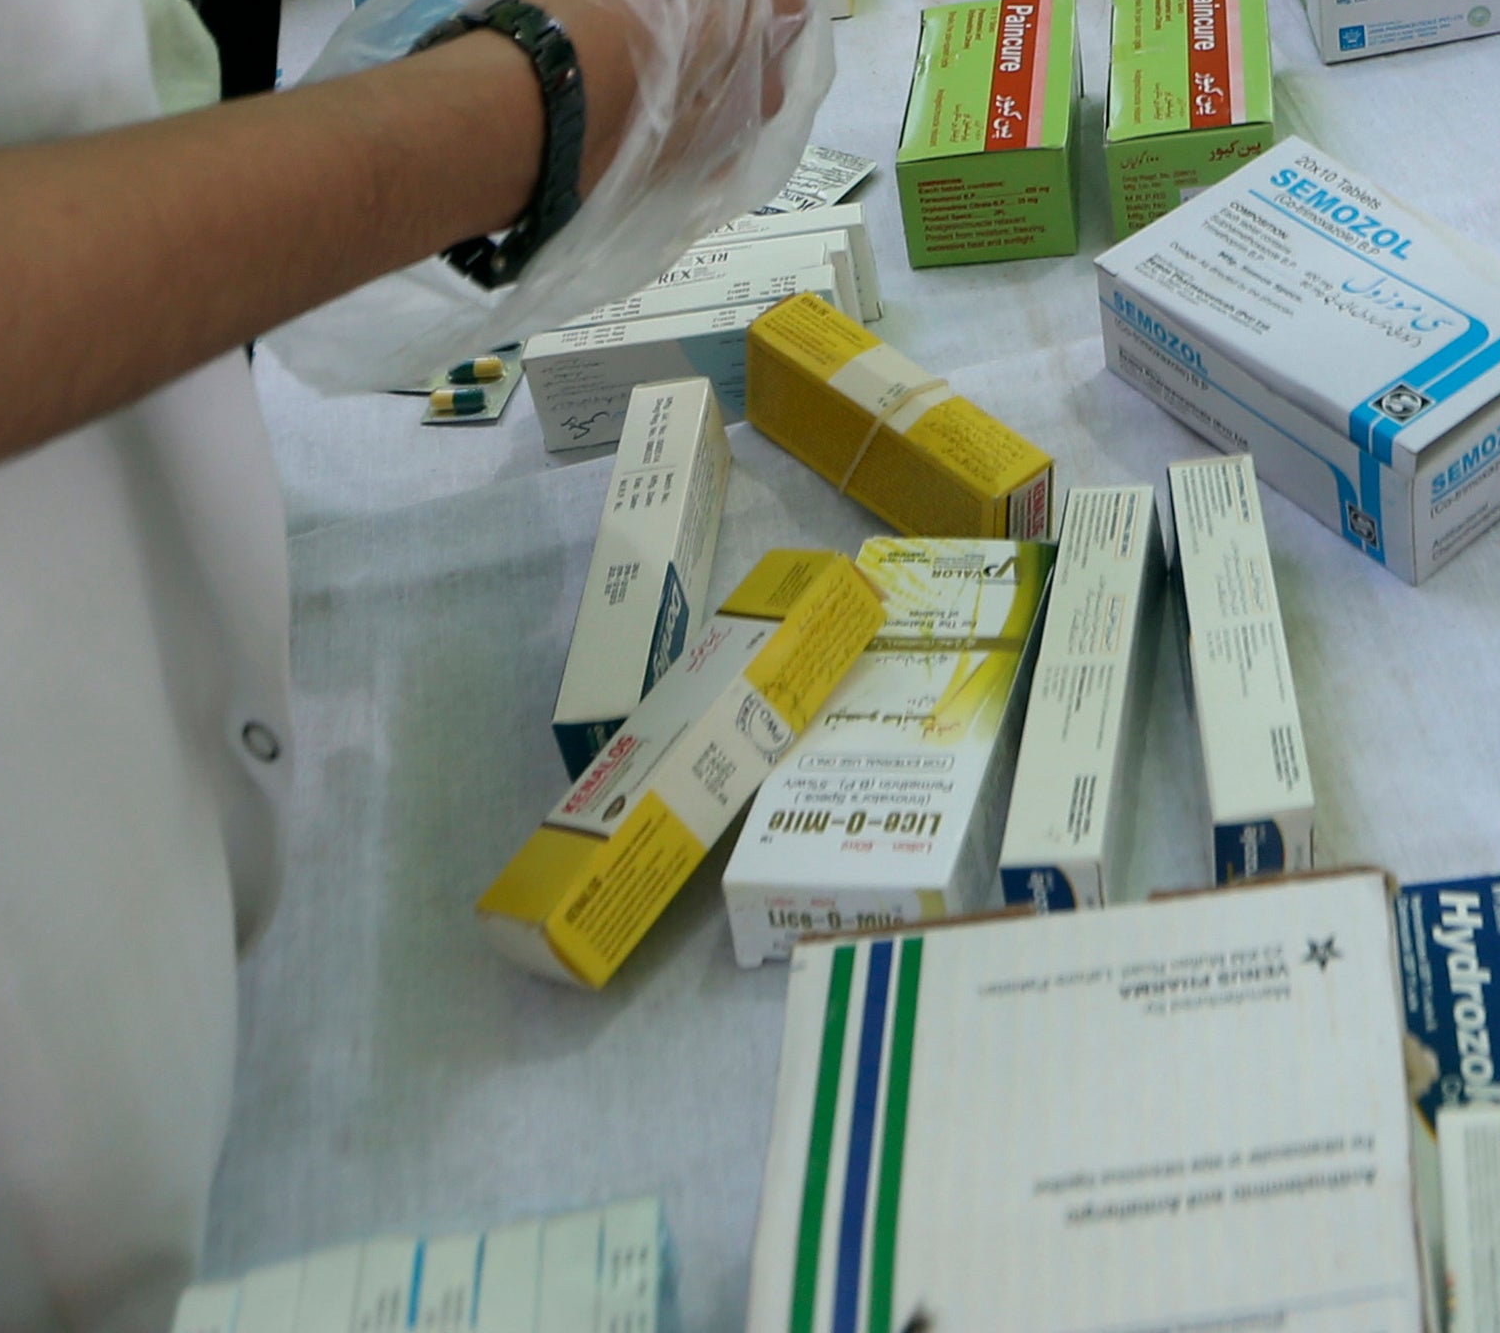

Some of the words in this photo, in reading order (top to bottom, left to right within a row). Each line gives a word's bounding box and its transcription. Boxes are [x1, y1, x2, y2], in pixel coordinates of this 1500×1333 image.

[1000, 4, 1033, 72] Paincure
[1295, 154, 1338, 184] 20x10
[1336, 178, 1383, 210] Tablets
[1270, 168, 1414, 261] SEMOZOL
[1273, 191, 1360, 249] (Co-trimoxazole)
[657, 267, 693, 285] REX
[693, 251, 729, 264] REX
[1113, 290, 1209, 378] SEMOZOL
[930, 567, 982, 579] VALOR
[767, 808, 943, 838] Lice-O-Mite
